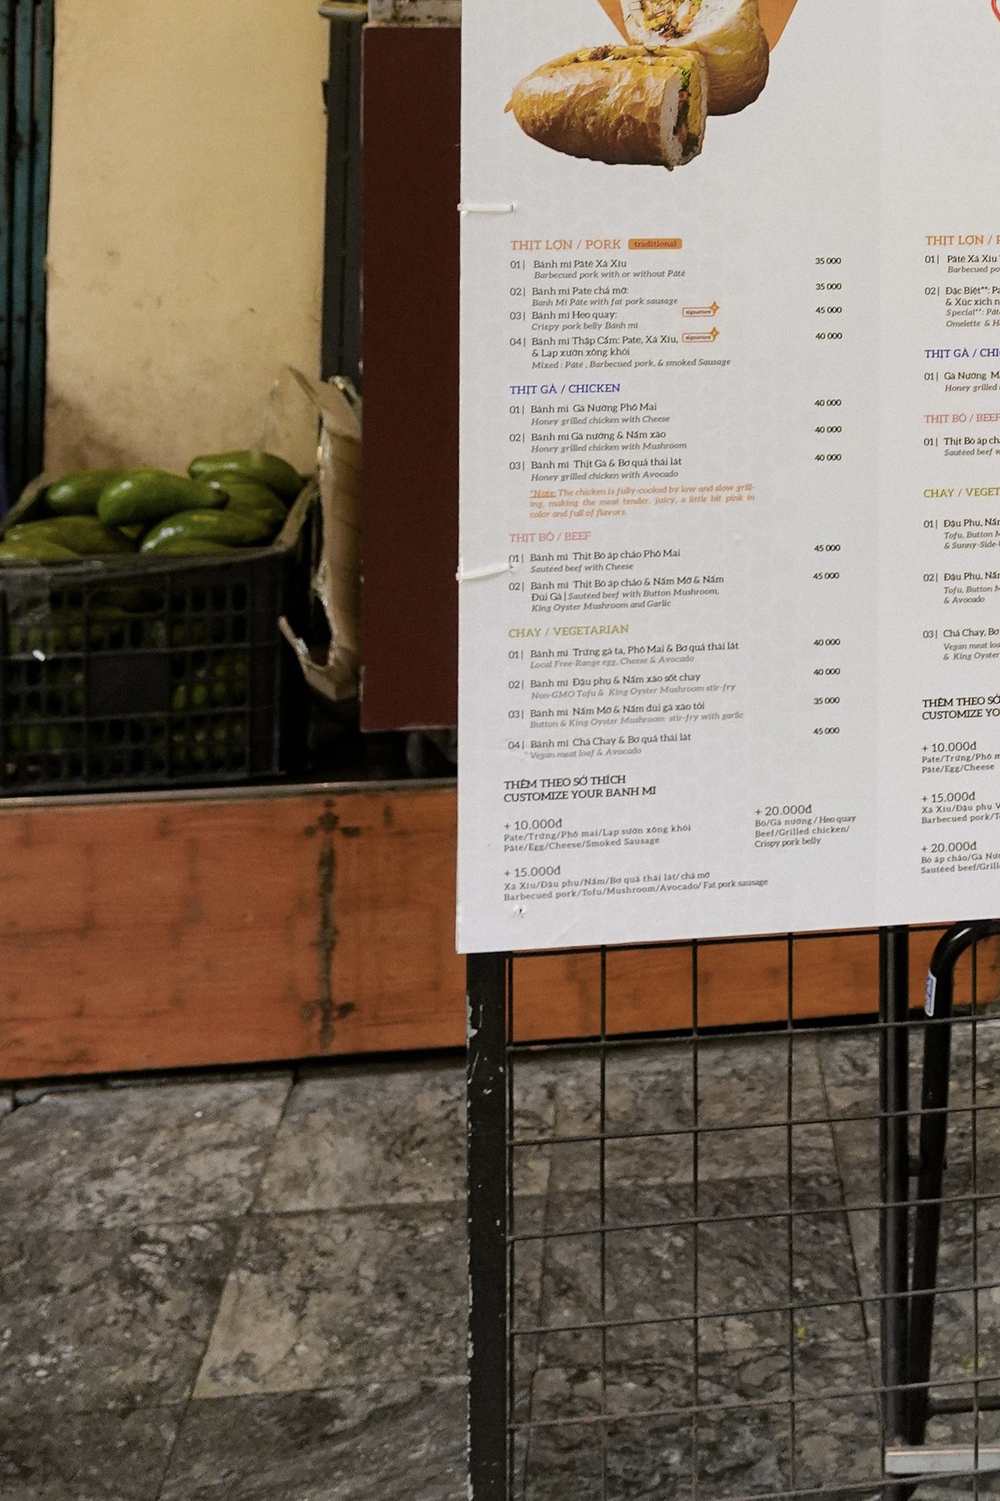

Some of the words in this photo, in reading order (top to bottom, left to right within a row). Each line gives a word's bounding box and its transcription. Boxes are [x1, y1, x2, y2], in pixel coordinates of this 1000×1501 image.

[586, 239, 621, 249] PORK
[634, 240, 677, 249] traditional
[816, 257, 825, 265] 35
[827, 257, 842, 265] 000
[534, 271, 577, 279] Barbecued
[579, 271, 598, 280] pork
[816, 283, 825, 291] 35
[610, 298, 622, 306] fat
[625, 297, 644, 306] pork
[816, 306, 825, 314] 45
[827, 306, 842, 314] 000
[568, 383, 621, 393] CHICKEN
[531, 418, 559, 426] Honey
[561, 417, 587, 426] grilled
[589, 416, 619, 424] chicken
[642, 415, 670, 423] Cheese
[923, 489, 954, 498] CHAY
[565, 531, 591, 541] BEEF
[944, 532, 964, 540] Tofu,
[508, 628, 541, 638] CHAY
[553, 624, 629, 636] VEGETARIAN
[922, 707, 983, 720] CUSTOMIZE
[569, 718, 589, 727] King
[621, 716, 665, 724] Mushroom
[722, 712, 743, 720] garlic
[931, 741, 977, 752] 10.000đ
[504, 788, 568, 802] CUSTOMIZE
[571, 789, 603, 799] YOUR
[606, 787, 639, 797] BANH
[642, 786, 656, 795] MI
[931, 792, 975, 803] 15.000đ
[765, 804, 812, 817] 20.000đ
[921, 813, 967, 824] Barbecued
[514, 818, 562, 831] 10.000đ
[931, 842, 976, 853] 20.000đ
[514, 865, 561, 878] 15.000đ
